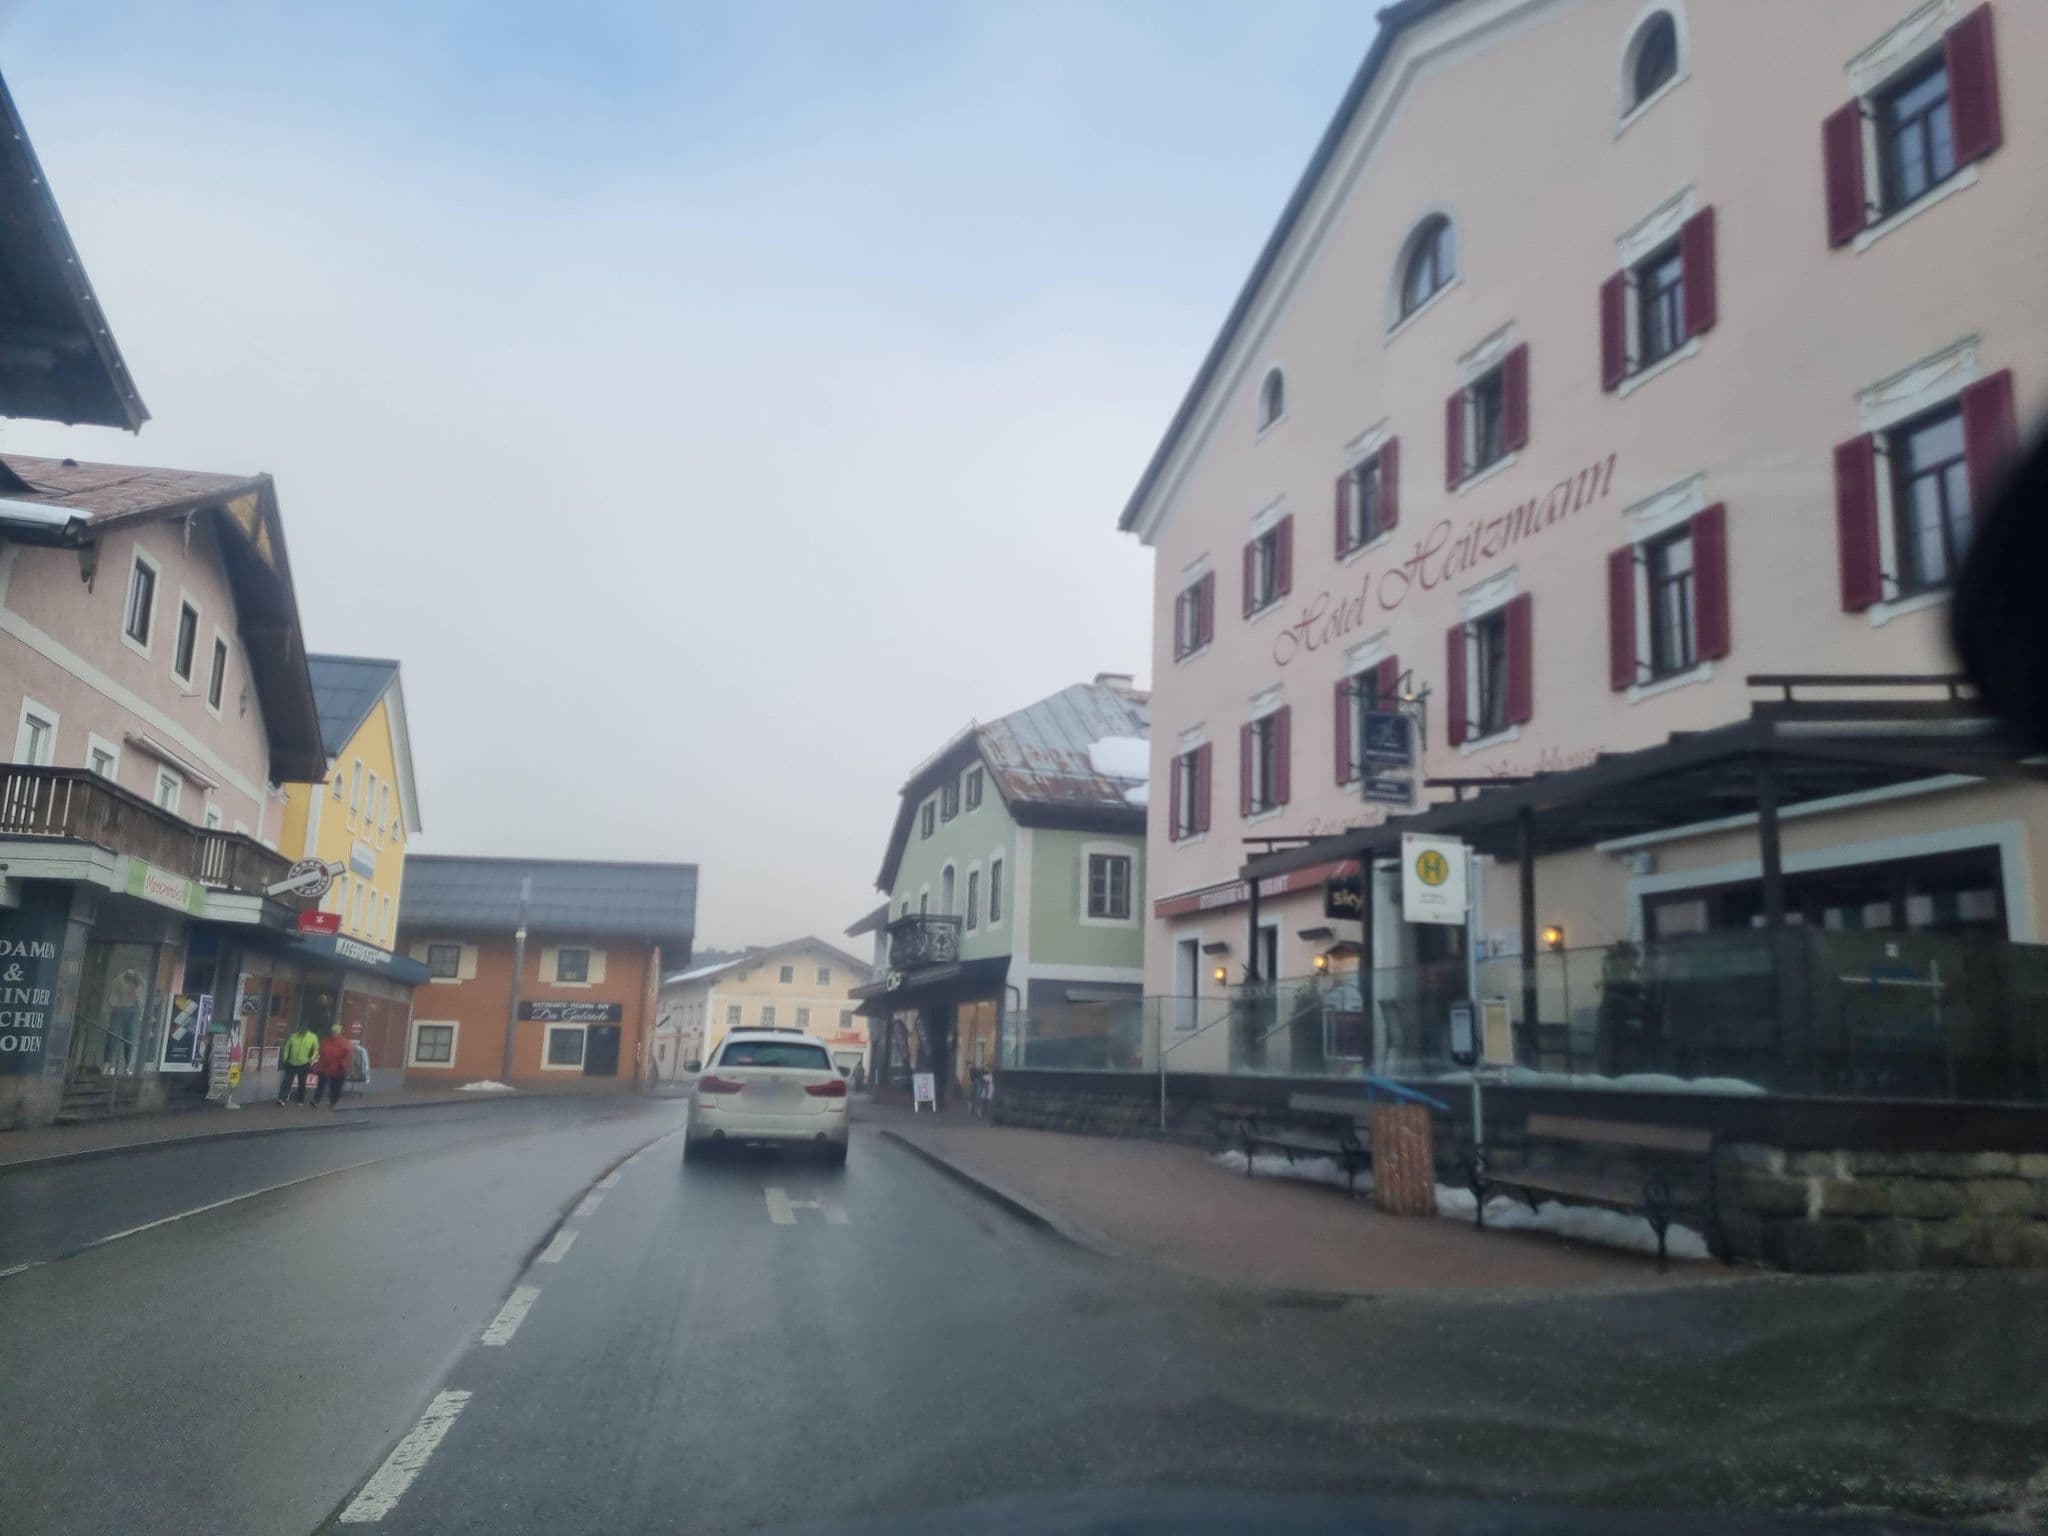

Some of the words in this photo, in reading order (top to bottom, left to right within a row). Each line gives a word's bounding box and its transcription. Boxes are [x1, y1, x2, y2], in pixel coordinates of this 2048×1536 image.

[1273, 574, 1369, 667] Hotel
[1378, 453, 1617, 611] Heitzmann
[1333, 888, 1361, 911] sky
[0, 939, 56, 959] DAMEN
[2, 962, 24, 981] &
[0, 987, 50, 1005] INDER
